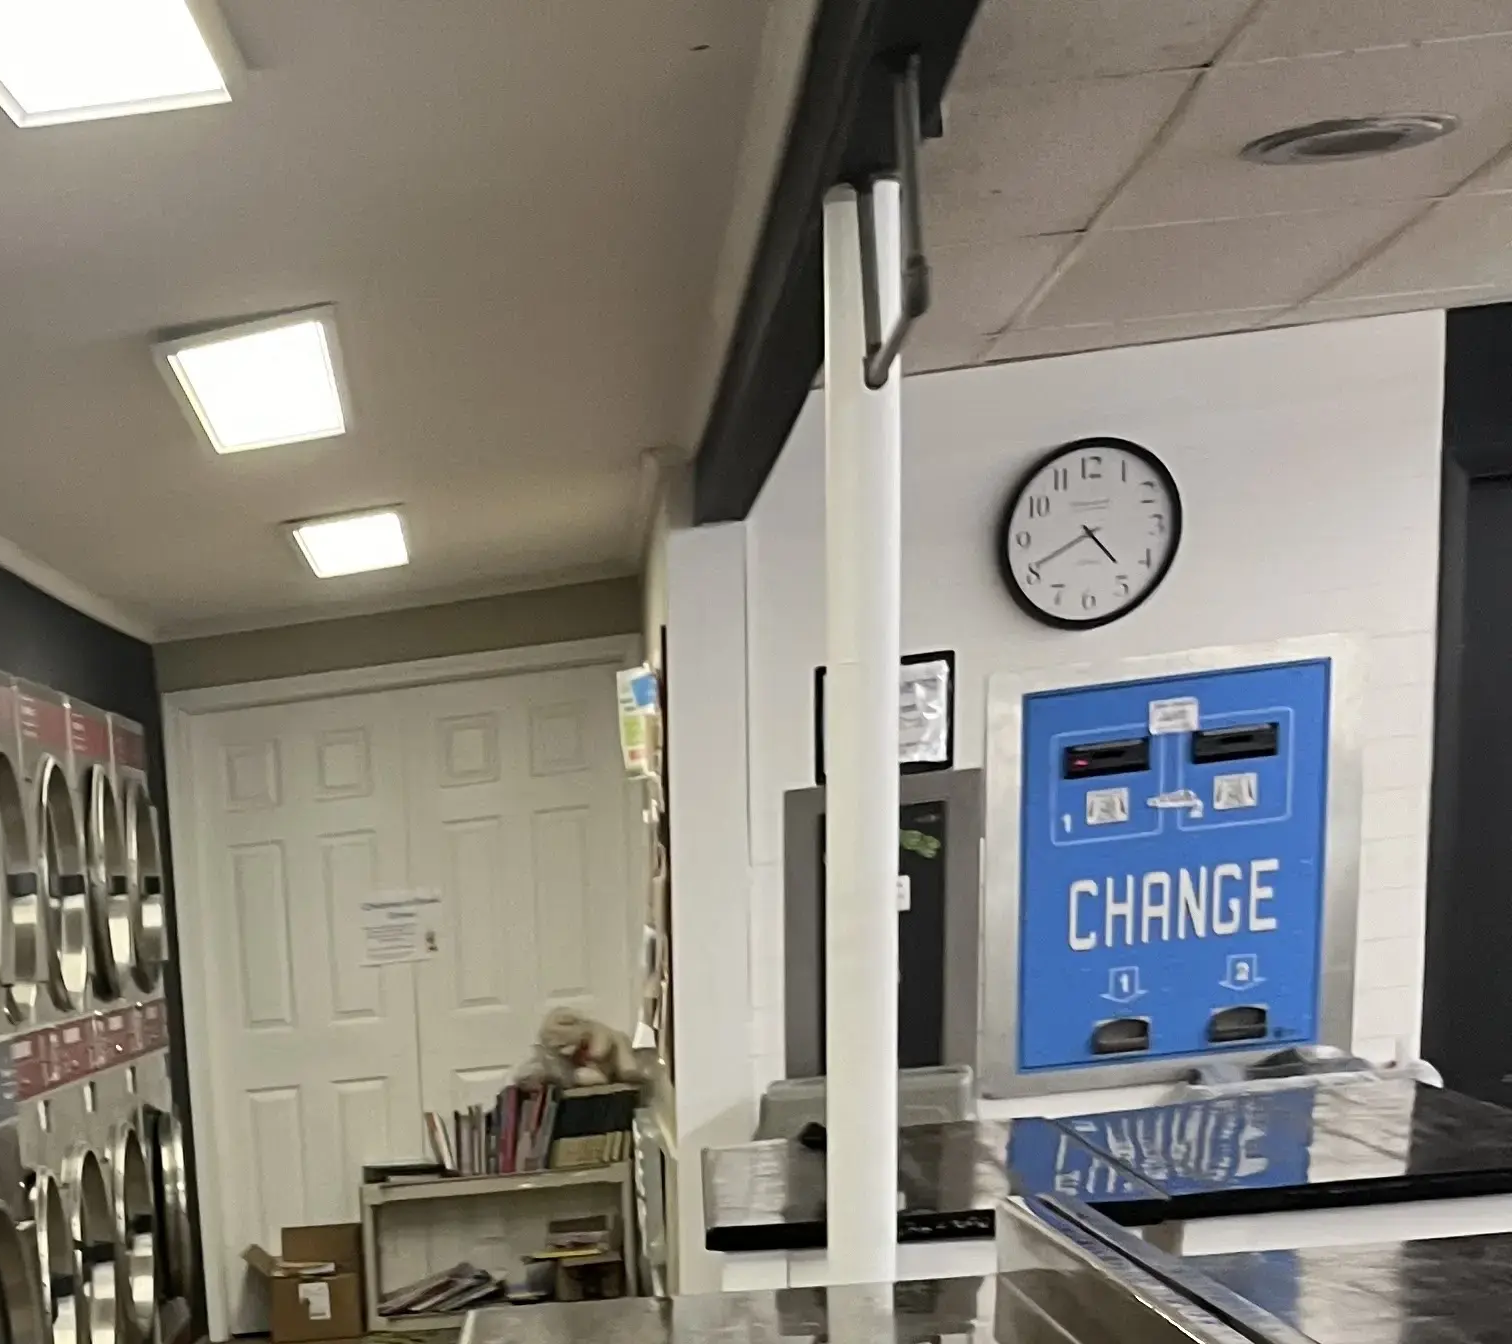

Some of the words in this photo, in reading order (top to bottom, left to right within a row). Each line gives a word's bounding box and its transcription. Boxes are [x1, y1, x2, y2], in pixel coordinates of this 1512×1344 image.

[1054, 467, 1068, 491] 11
[1081, 456, 1102, 479] 12
[1121, 459, 1127, 482] 1
[1029, 495, 1050, 519] 10
[1027, 562, 1041, 585] 8
[1050, 583, 1066, 605] 7
[1113, 574, 1129, 597] 5
[1068, 858, 1280, 952] CHANGE
[1235, 961, 1251, 981] 2
[1118, 973, 1129, 994] 1
